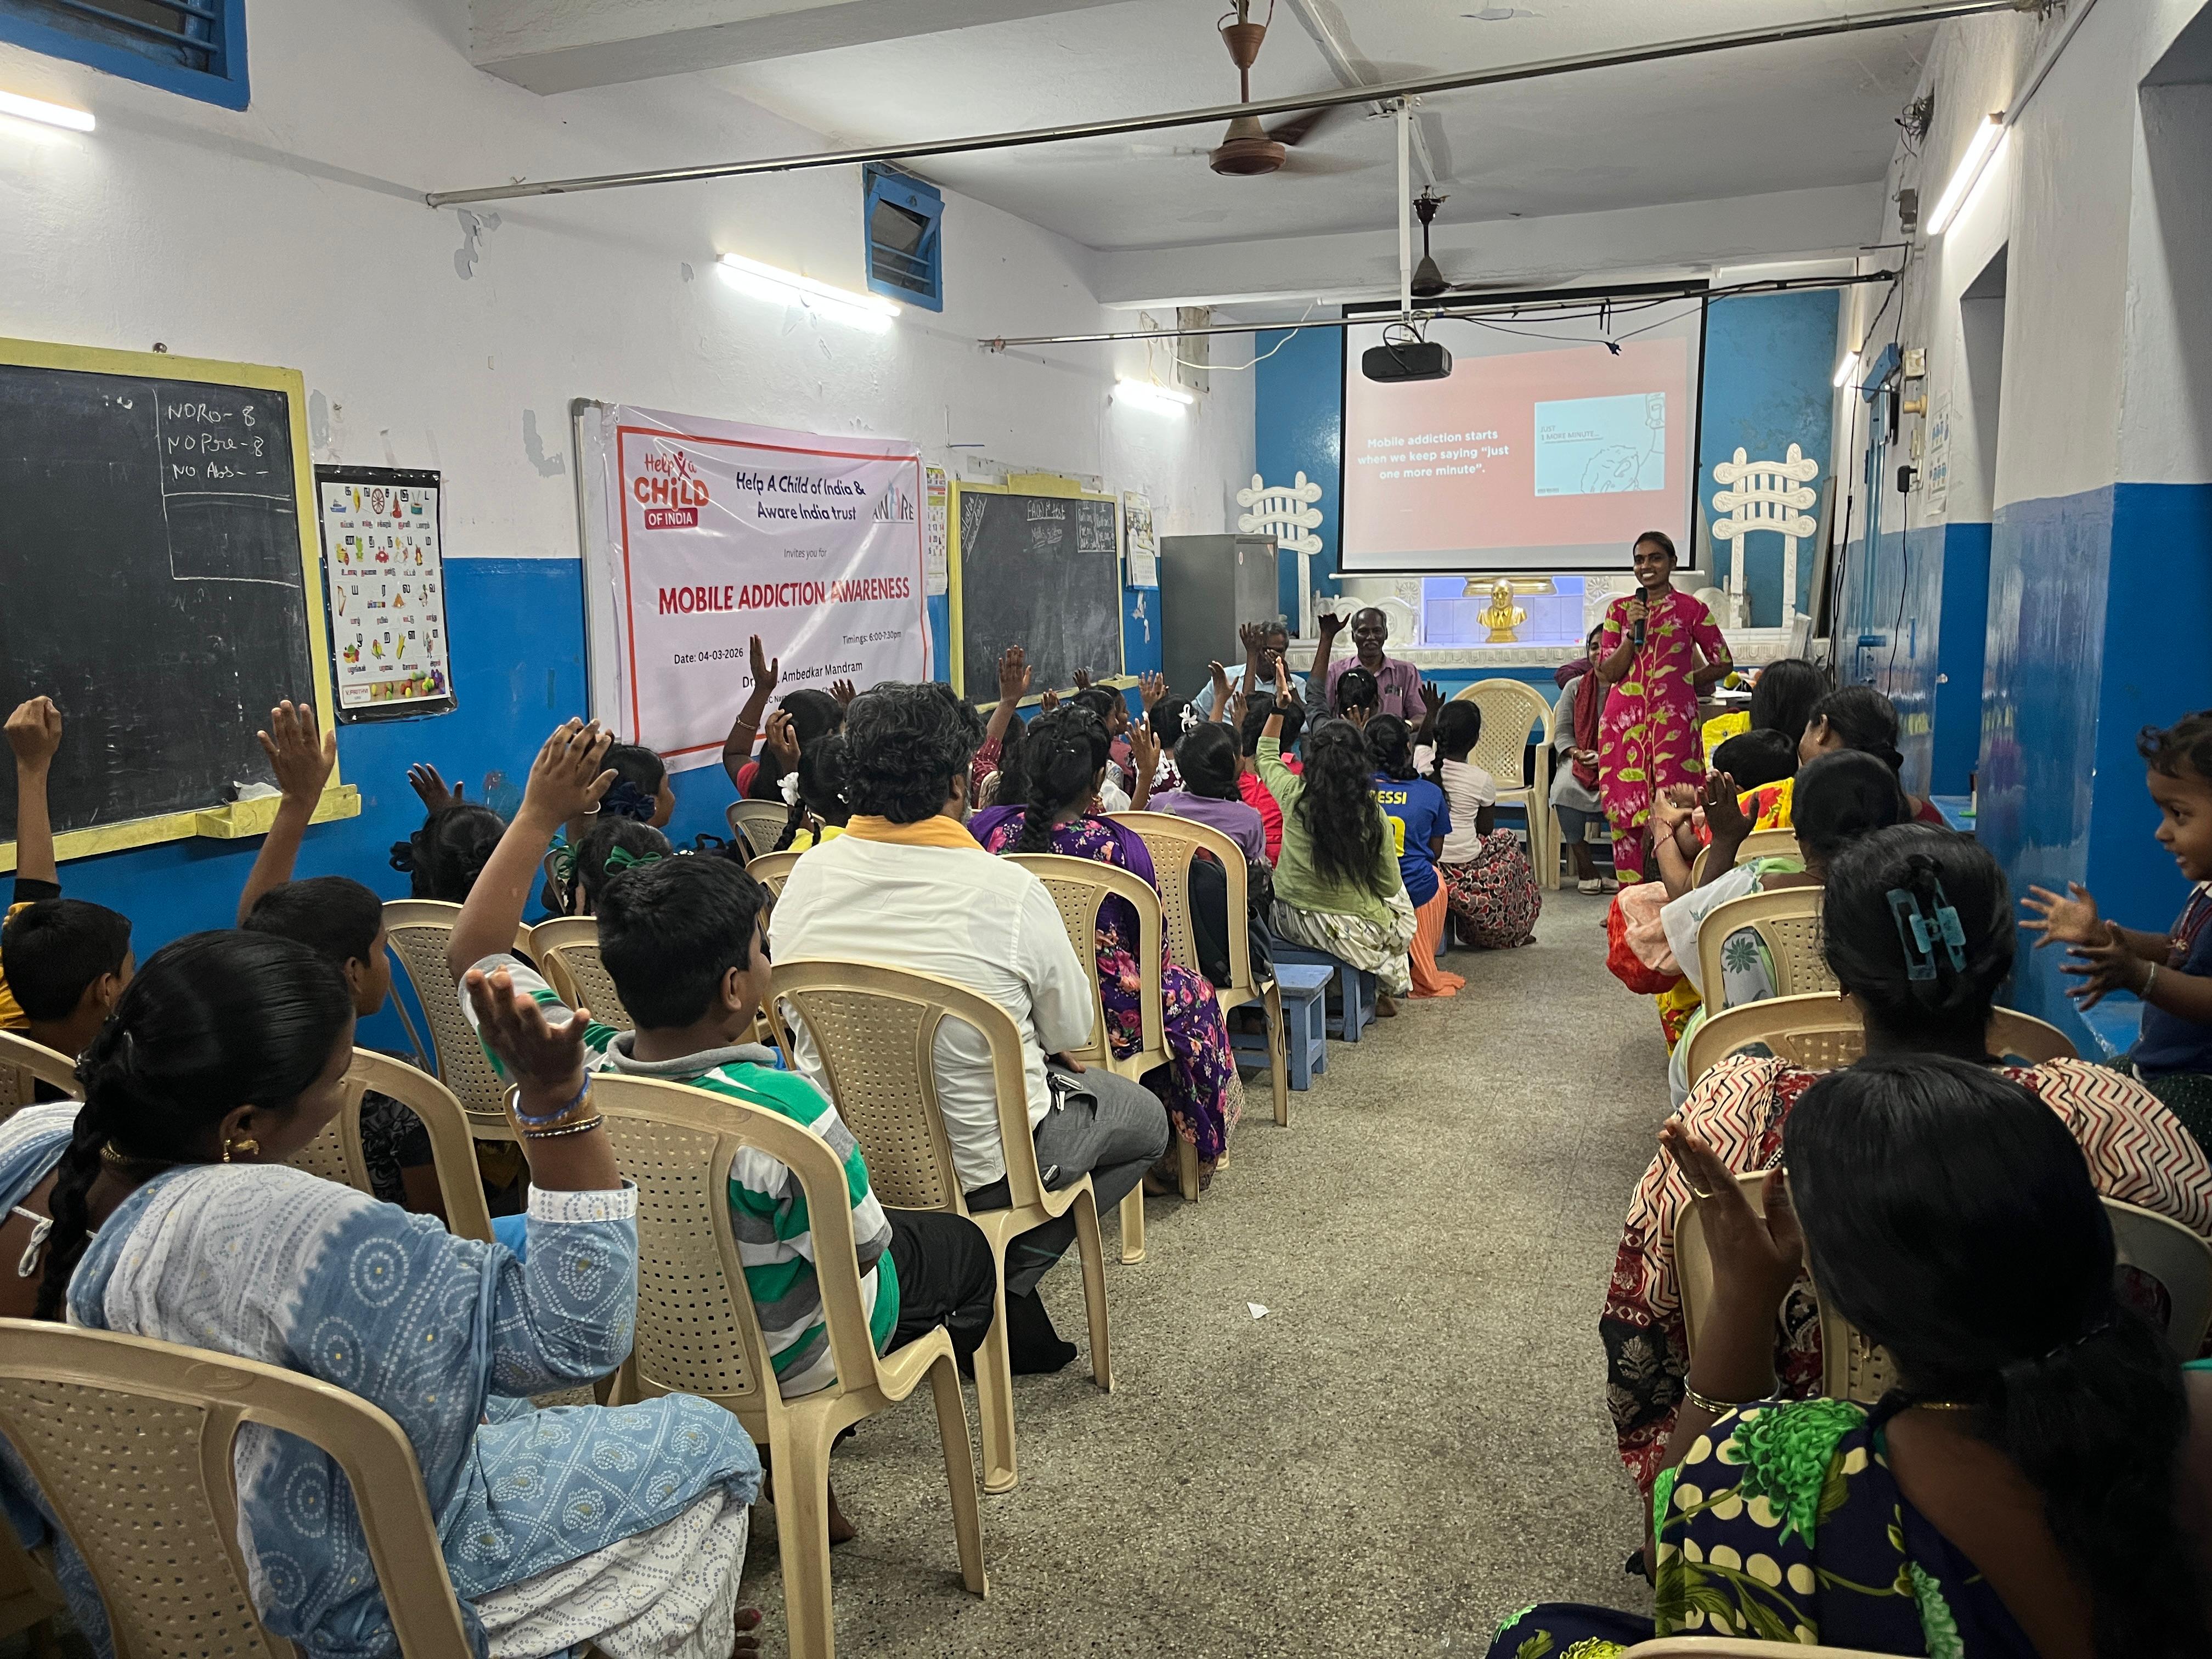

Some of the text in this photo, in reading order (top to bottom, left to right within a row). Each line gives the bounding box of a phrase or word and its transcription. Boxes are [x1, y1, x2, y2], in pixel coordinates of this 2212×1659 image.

[242, 405, 255, 426] 8
[1367, 430, 1498, 448] Mobile addiction starts
[644, 453, 674, 476] Help
[1357, 454, 1387, 465] when
[1390, 454, 1406, 463] we
[1409, 452, 1437, 462] keep
[1440, 448, 1478, 460] saying
[1379, 470, 1400, 479] one
[1403, 468, 1432, 478] more
[736, 472, 867, 496] Help A Child of India &
[648, 512, 693, 526] OF INDIA
[757, 501, 856, 520] Aware India trust
[784, 549, 827, 560] Invites you for
[659, 577, 910, 615] MOBILE ADDICTION AWARENESS
[842, 635, 868, 645] Timings:
[674, 647, 744, 664] Date: 04-03-2026
[782, 665, 823, 684] Ambedkar
[825, 661, 863, 676] Mandram
